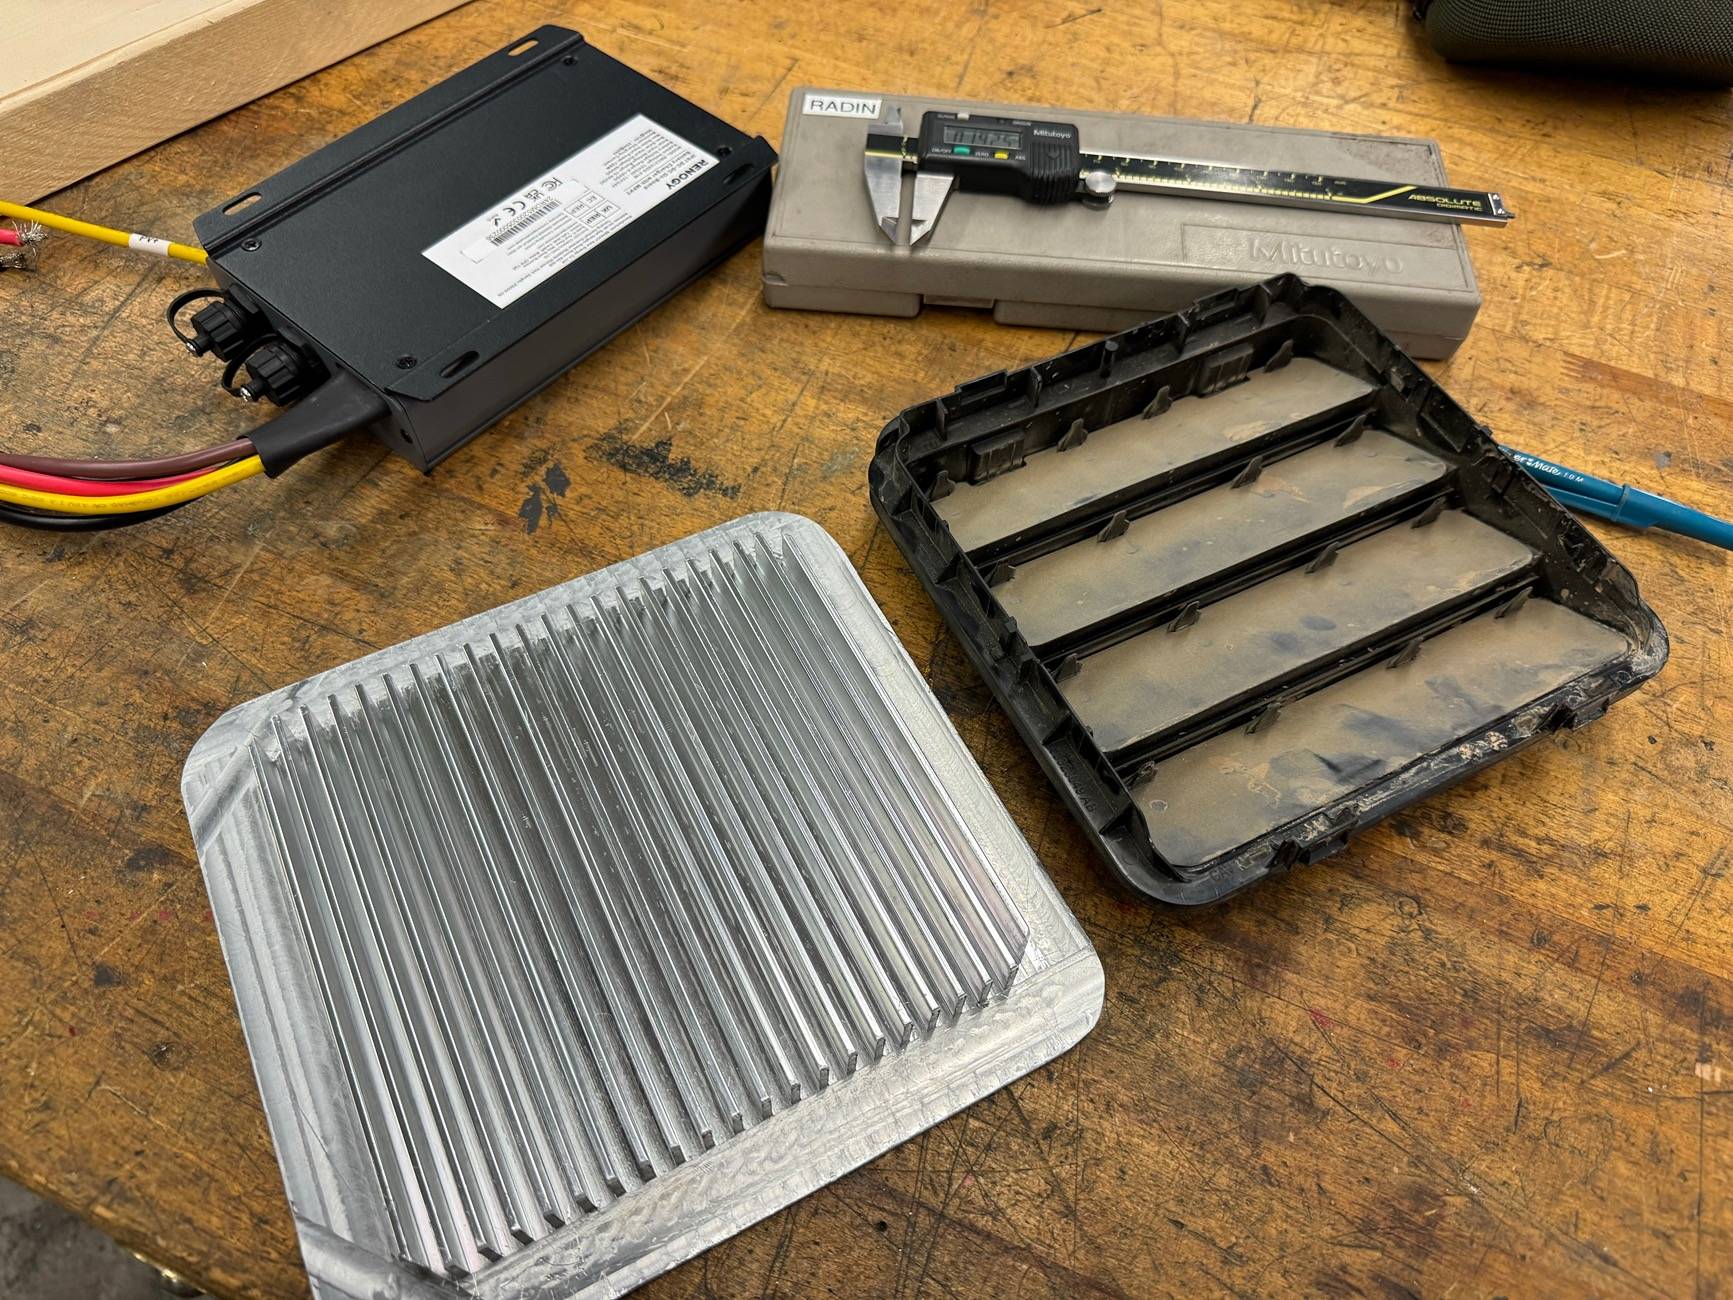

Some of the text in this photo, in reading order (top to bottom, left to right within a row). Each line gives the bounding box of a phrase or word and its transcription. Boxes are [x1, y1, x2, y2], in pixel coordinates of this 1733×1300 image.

[810, 99, 876, 114] RADIN
[1033, 129, 1072, 139] Mitutoyo
[664, 159, 708, 189] RENOGY
[1407, 194, 1482, 207] ABSOLUTE
[583, 204, 613, 224] UK REP
[1253, 238, 1404, 273] Mitutoyo
